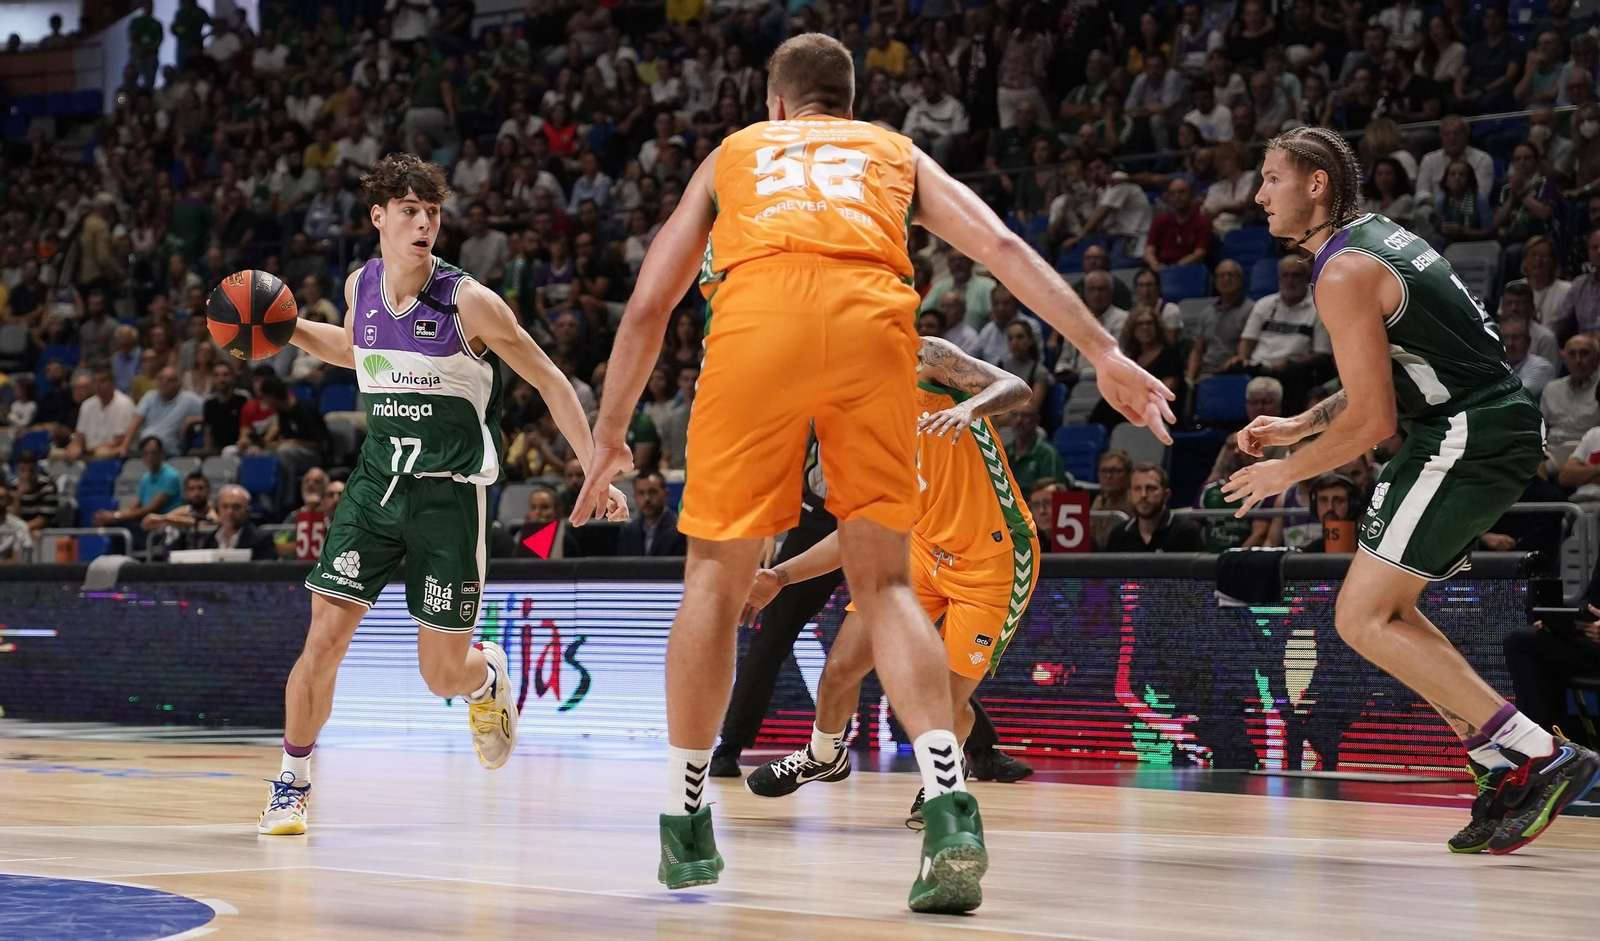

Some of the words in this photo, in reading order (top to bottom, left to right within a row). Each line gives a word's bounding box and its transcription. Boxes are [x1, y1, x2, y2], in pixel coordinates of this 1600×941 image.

[754, 200, 828, 221] FOREVER
[391, 371, 442, 388] Unicaja
[372, 398, 433, 421] málaga
[390, 437, 422, 474] 17
[296, 521, 325, 558] 55
[1056, 504, 1084, 548] 5
